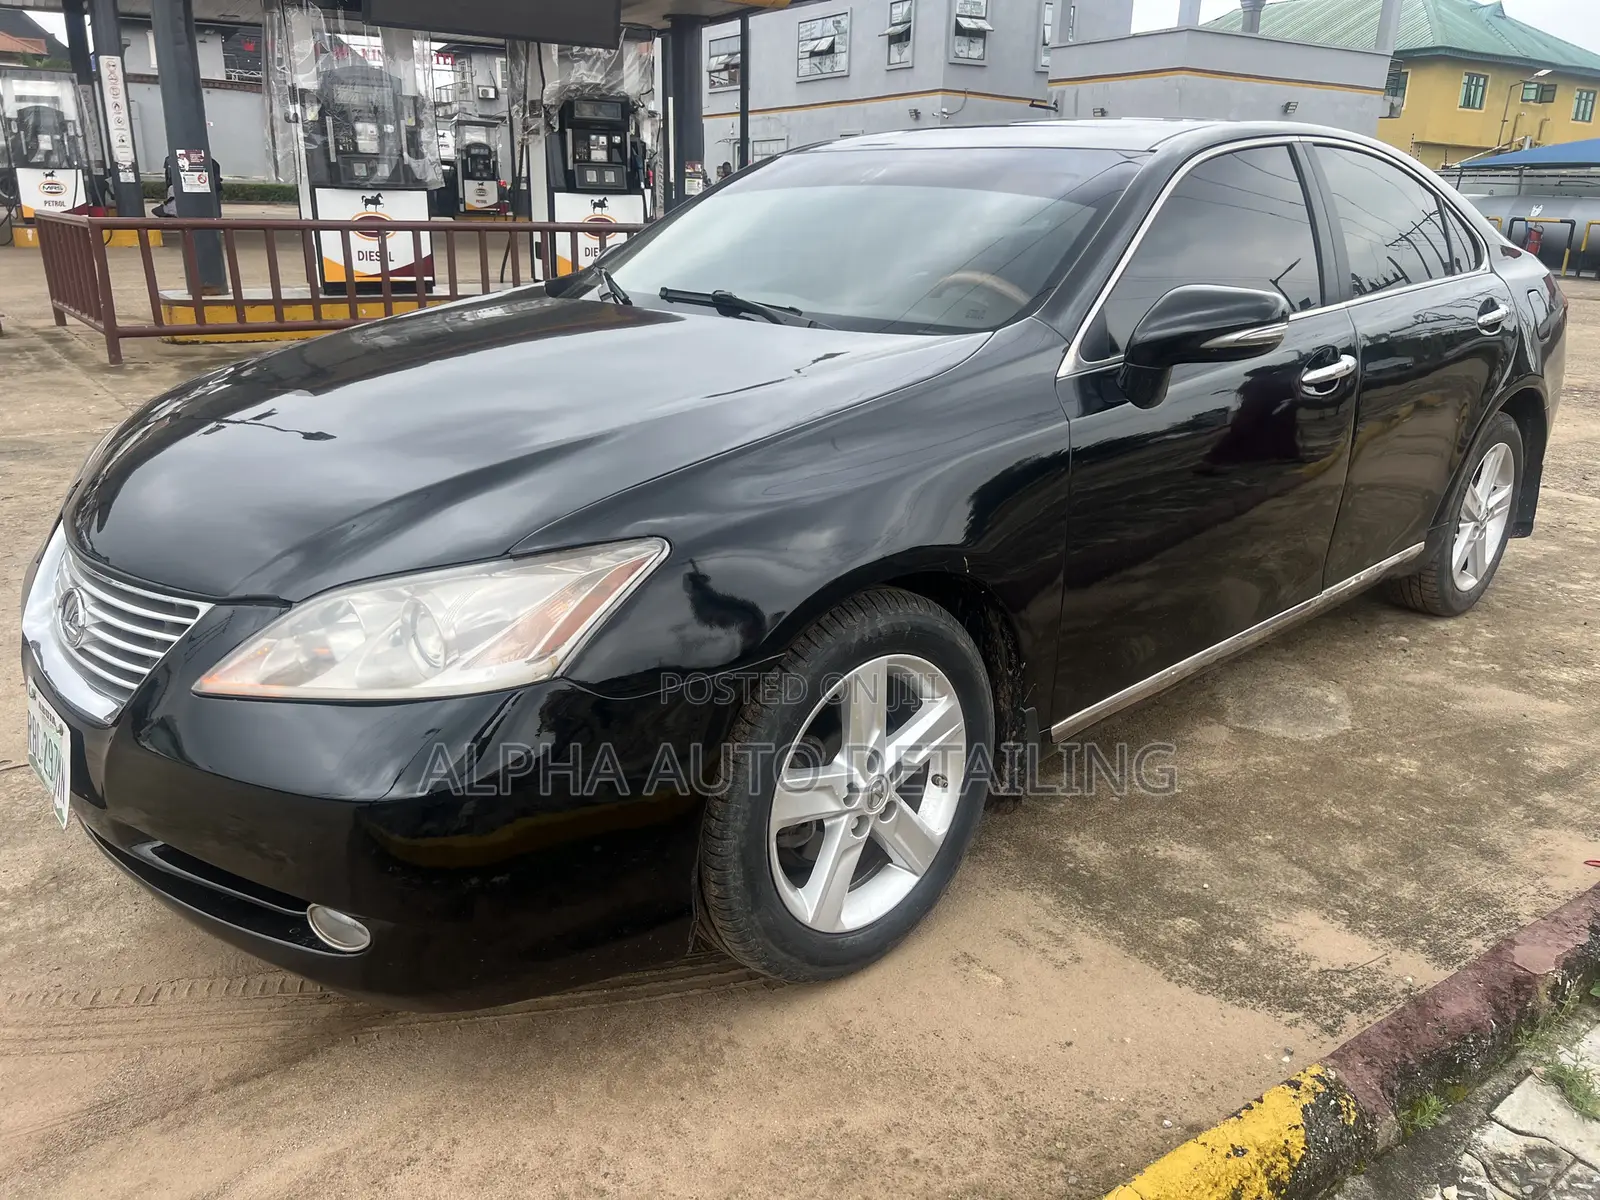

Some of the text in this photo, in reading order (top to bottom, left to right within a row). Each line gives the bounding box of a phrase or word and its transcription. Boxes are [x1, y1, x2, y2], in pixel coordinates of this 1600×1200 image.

[43, 200, 67, 208] PETROL
[357, 250, 395, 262] DIESL
[584, 246, 599, 258] DIE
